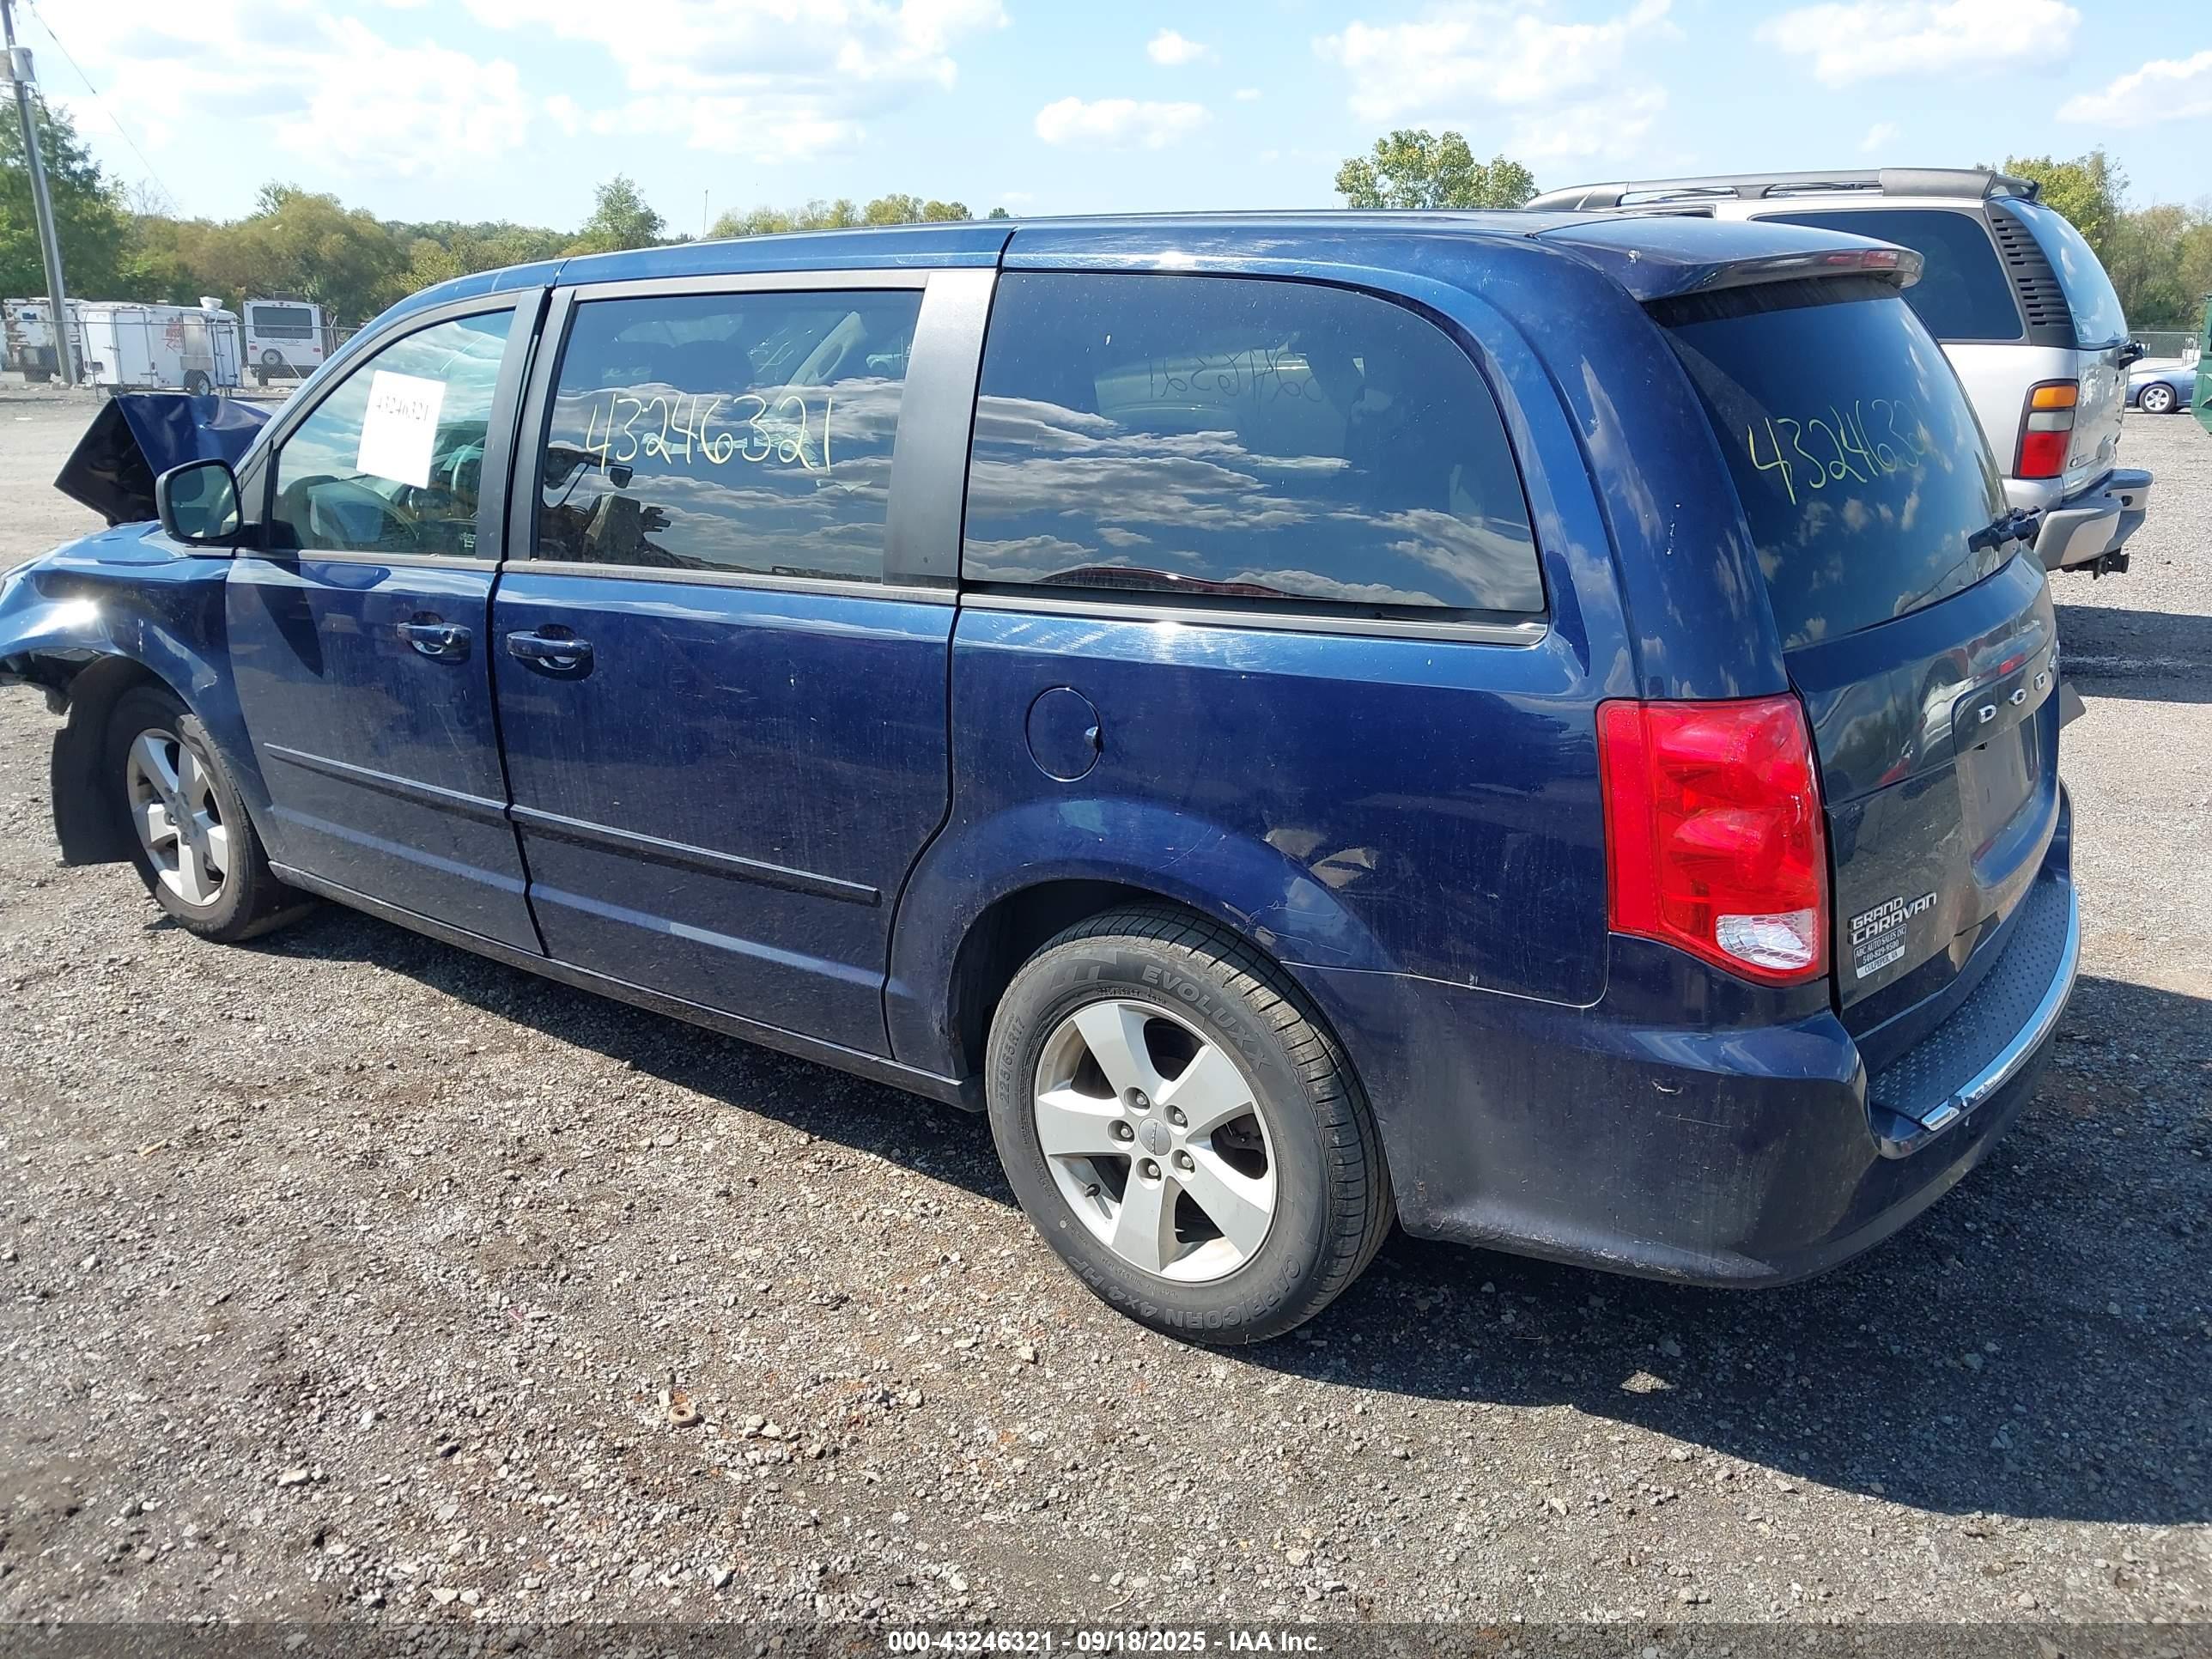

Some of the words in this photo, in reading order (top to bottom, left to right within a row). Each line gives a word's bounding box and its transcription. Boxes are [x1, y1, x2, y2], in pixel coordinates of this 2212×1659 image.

[586, 392, 833, 475] 43246321
[1851, 896, 1904, 930] GRAND
[1851, 892, 1937, 945] CARAVAN
[1856, 945, 1867, 957] ABC
[1867, 939, 1881, 952] AUTO
[1881, 931, 1897, 945] SALES
[1141, 964, 1272, 1071] EVOLUXX
[999, 1016, 1025, 1105] 225/65R17
[1067, 1255, 1105, 1287] HP
[1164, 1254, 1301, 1329] CAPRICORN
